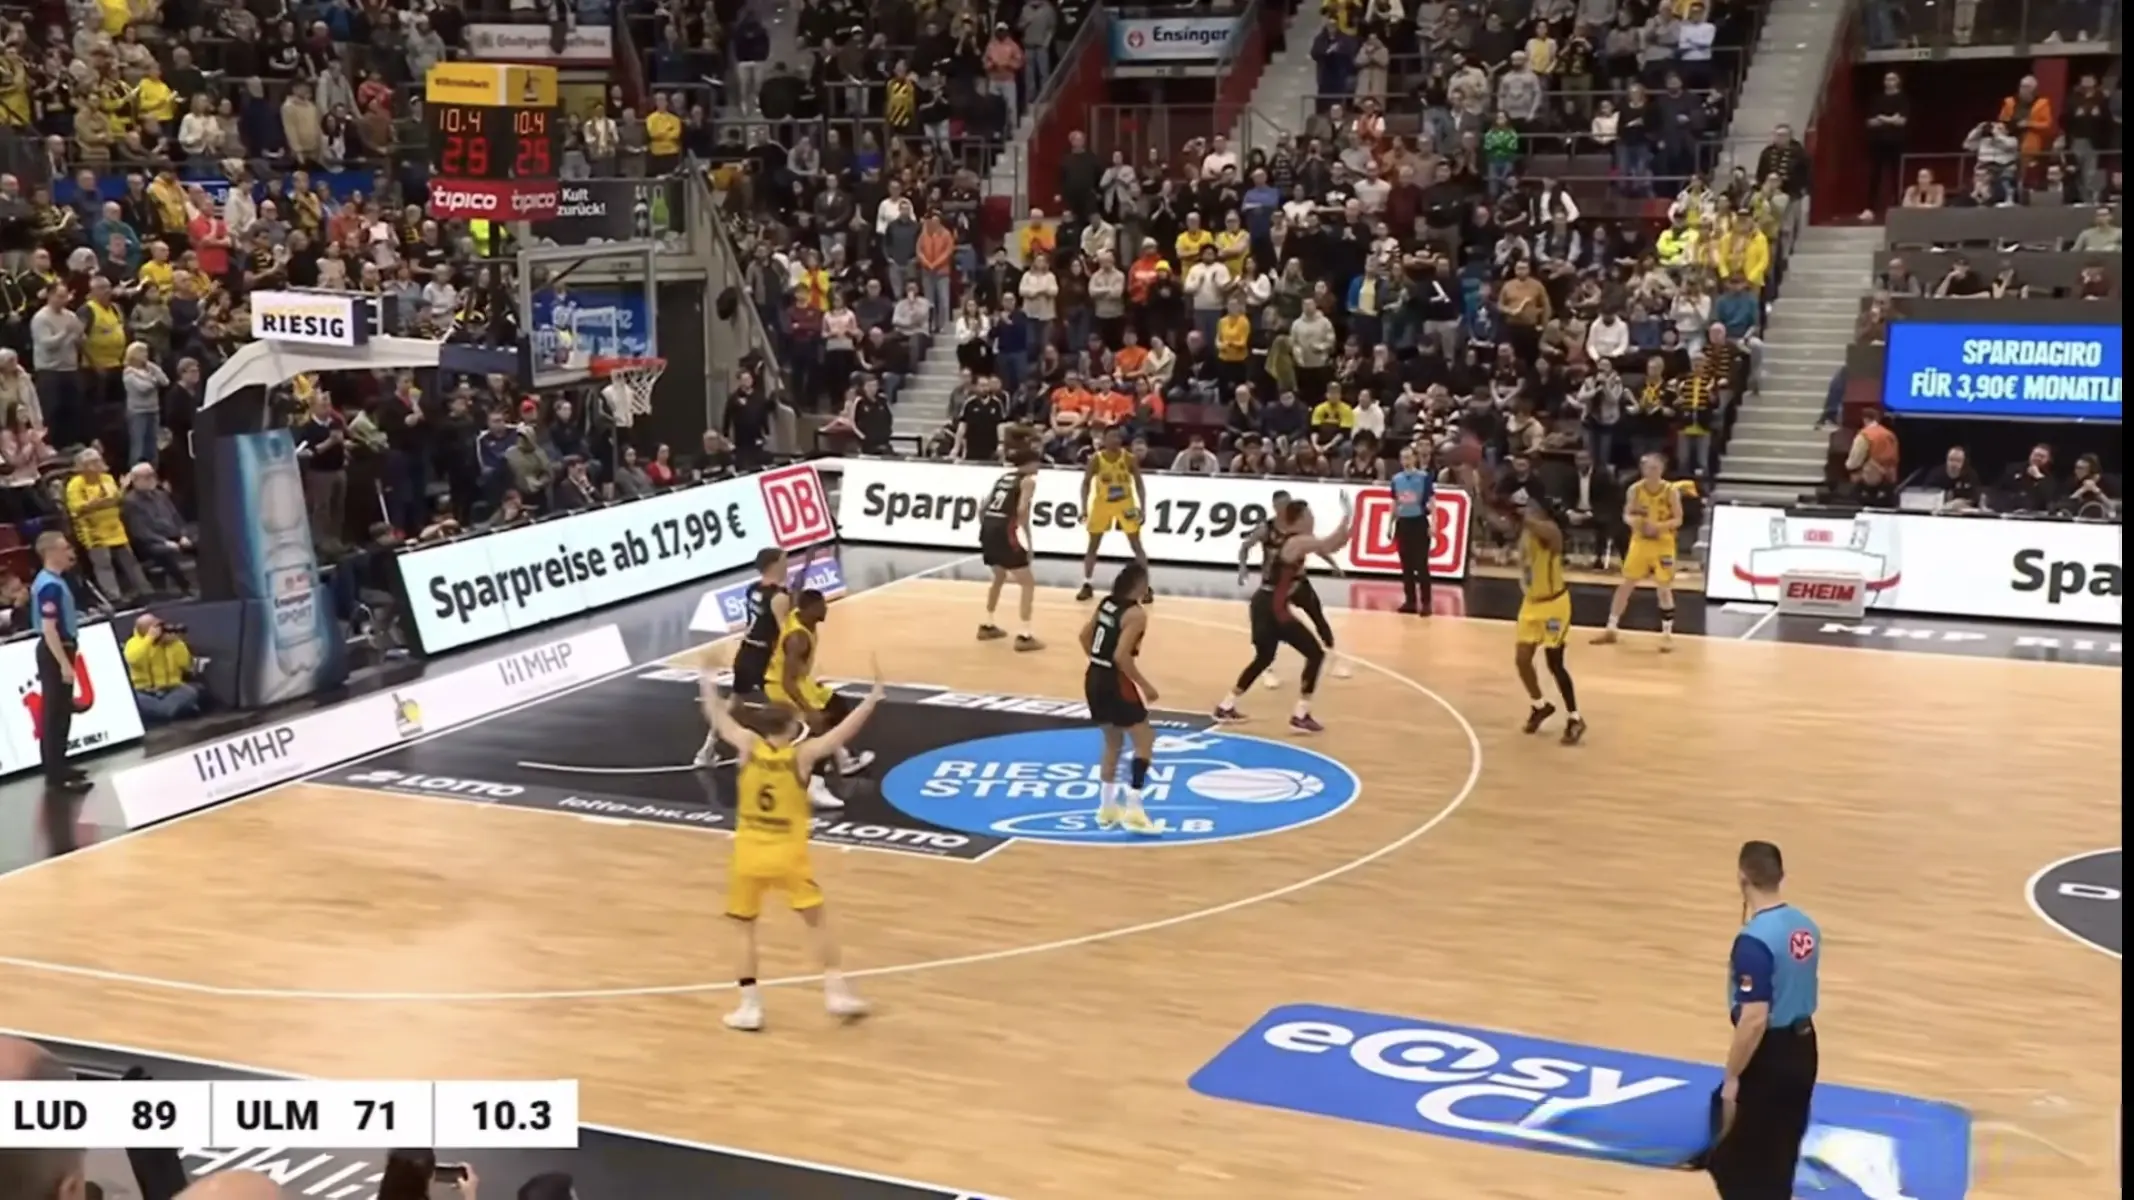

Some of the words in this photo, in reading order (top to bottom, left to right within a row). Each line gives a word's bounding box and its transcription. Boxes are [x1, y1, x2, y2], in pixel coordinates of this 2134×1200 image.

[1153, 26, 1230, 45] Ensinger
[440, 108, 482, 133] 10.4
[514, 111, 545, 134] 10.4
[433, 185, 497, 211] tipico
[511, 188, 556, 214] tipico
[562, 187, 589, 201] Kult
[556, 201, 607, 216] zurück!
[262, 312, 344, 338] RIESIG
[1962, 339, 2102, 367] SPARDAGIRO
[1910, 367, 1952, 398] FÜR
[1956, 374, 2018, 402] 3,90€
[774, 475, 823, 534] DB
[429, 544, 608, 623] Sparpreise
[610, 529, 650, 576] ab
[651, 508, 723, 560] 17,99
[726, 502, 747, 540] €
[1787, 582, 1855, 601] EHEIM
[528, 642, 573, 679] MHP
[227, 727, 296, 772] MHP
[398, 774, 525, 797] LOTTO
[757, 783, 777, 812] 6
[827, 822, 970, 848] LOTTO
